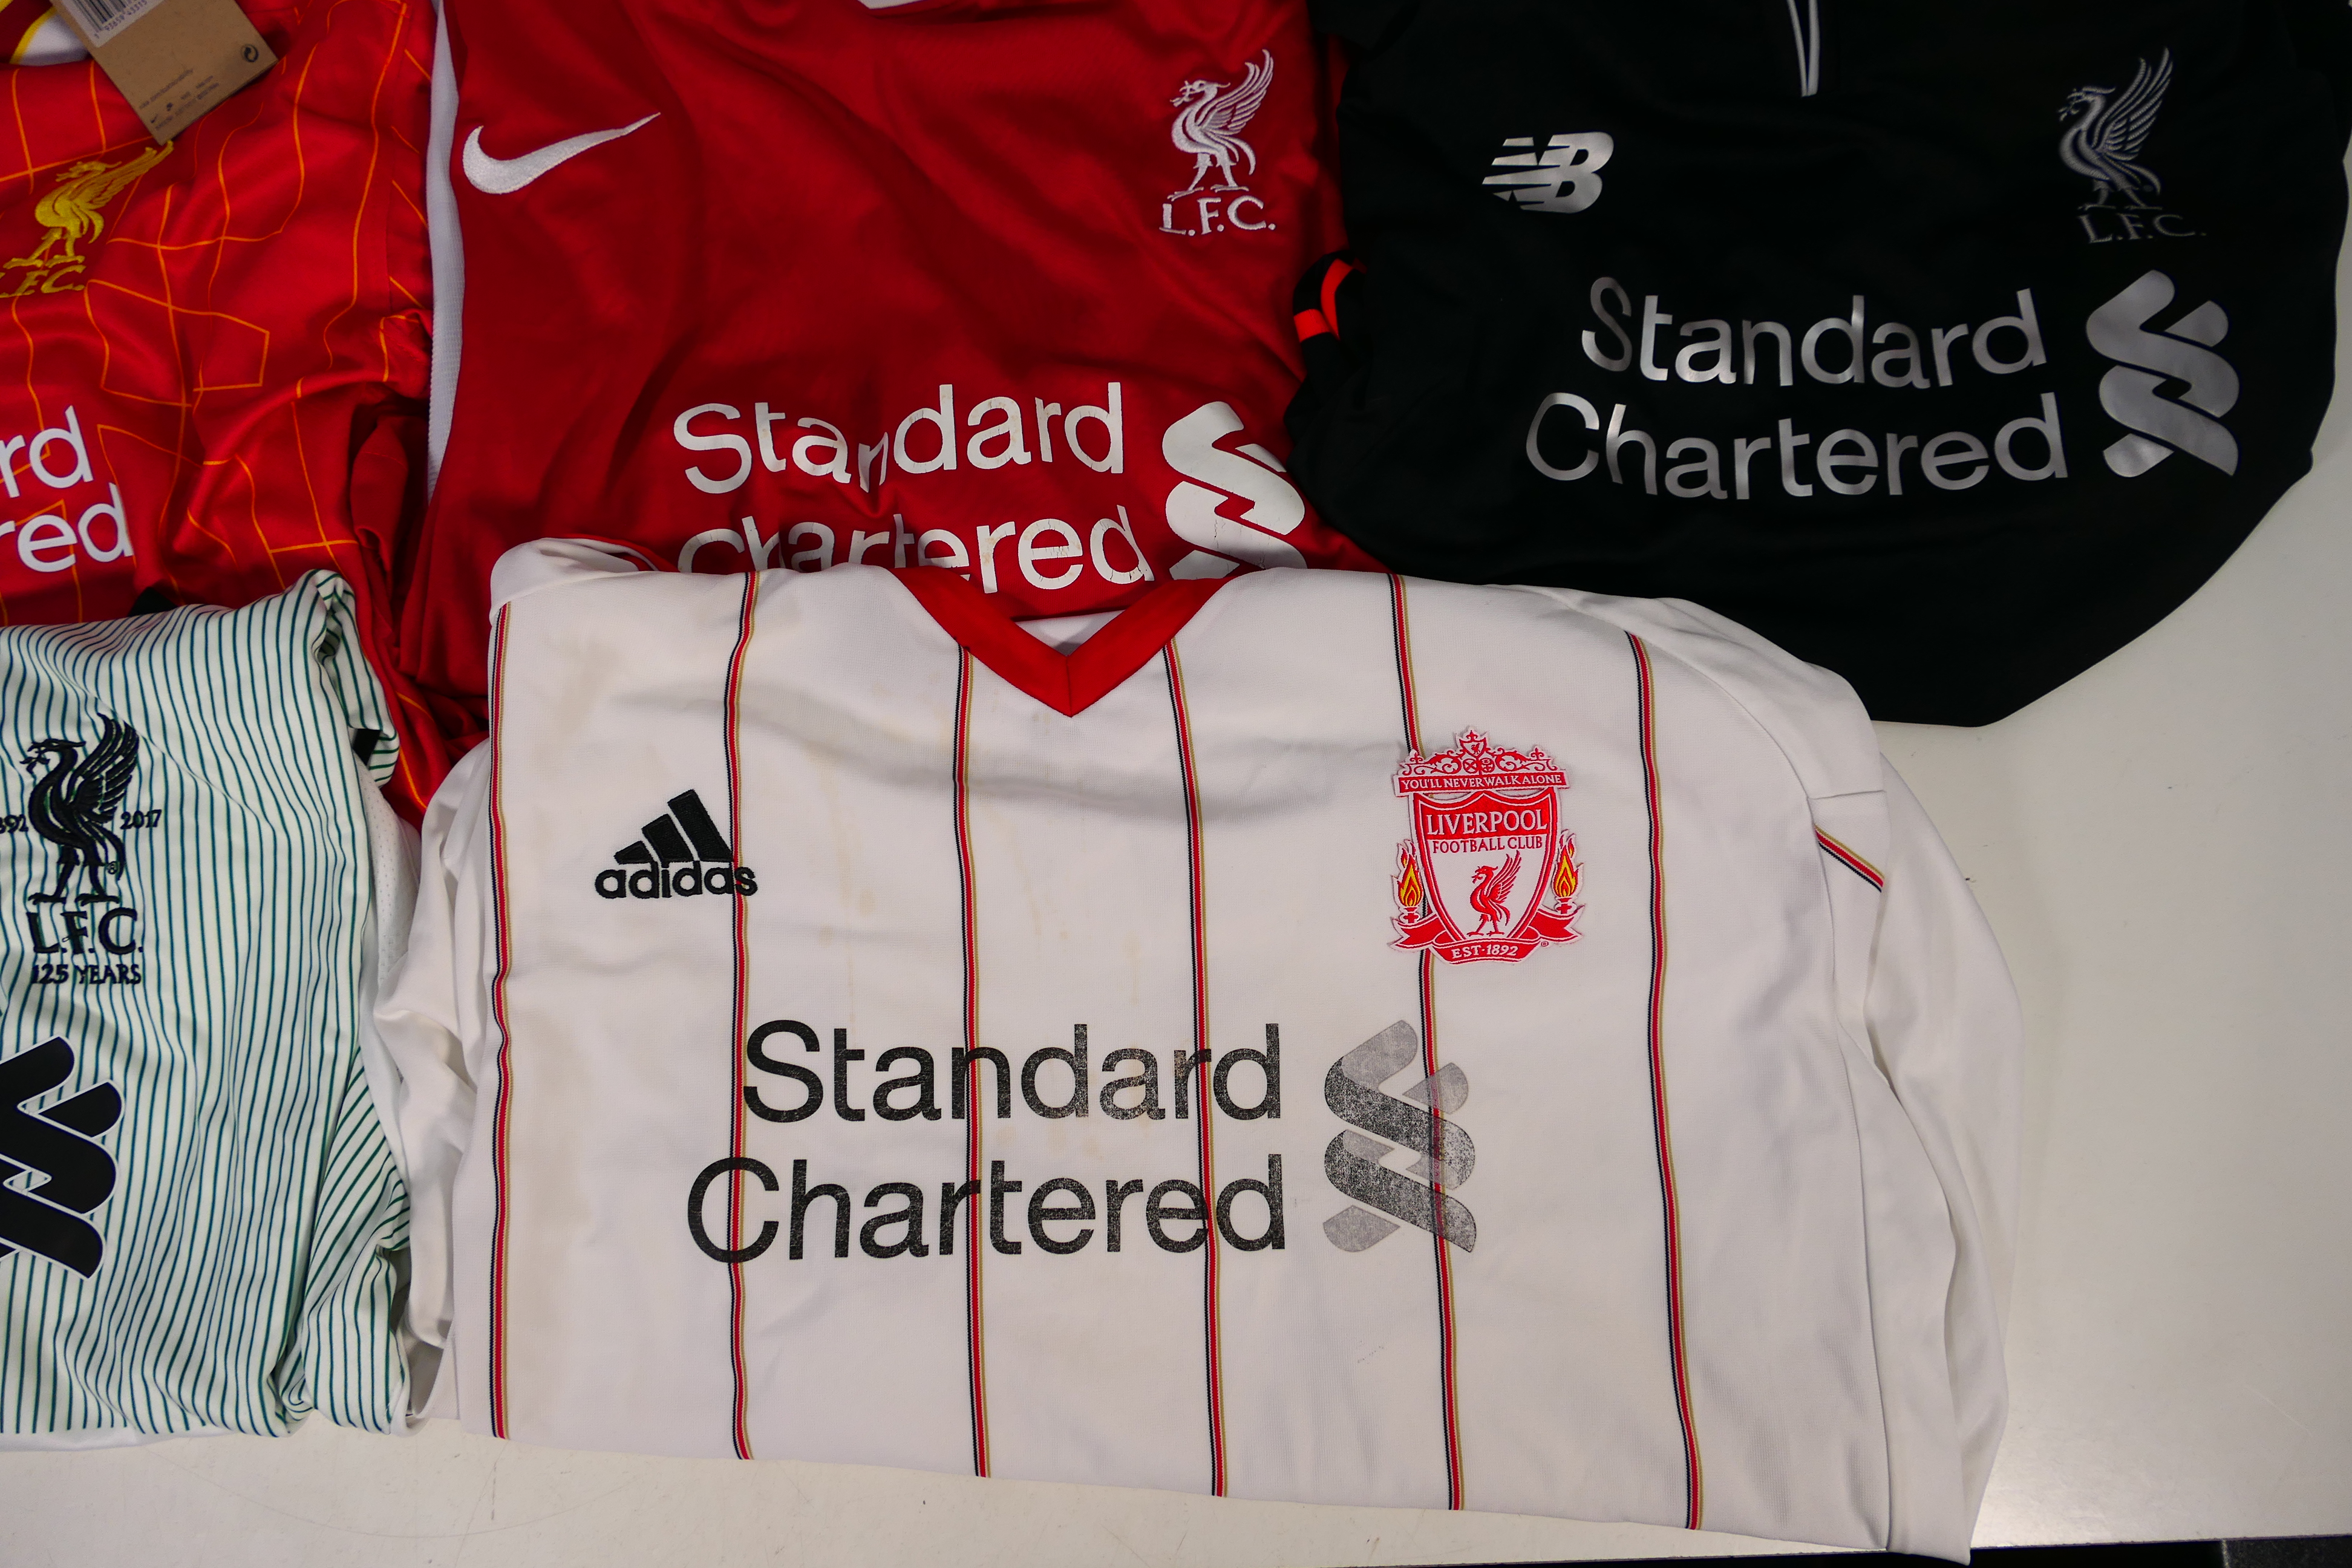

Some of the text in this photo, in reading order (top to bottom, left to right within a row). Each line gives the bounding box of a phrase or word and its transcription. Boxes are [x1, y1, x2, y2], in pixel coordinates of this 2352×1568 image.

[1158, 195, 1276, 236] L.F.C.
[2078, 212, 2207, 244] L.F.C.
[1581, 276, 2048, 390] Standard
[673, 381, 1124, 494] Standard
[1526, 391, 2069, 500] Chartered
[1401, 774, 1563, 790] YOU'LL NEVER WALK ALONE
[120, 809, 162, 829] 2017
[1426, 809, 1547, 835] LIVERPOOL
[1432, 835, 1543, 854] FOOTBALL CLUB
[594, 860, 758, 899] adidas
[26, 907, 144, 955] L.F.C.
[30, 963, 142, 985] 125 YEARS
[742, 1019, 1281, 1124] Standard
[687, 1153, 1285, 1263] Chartered
